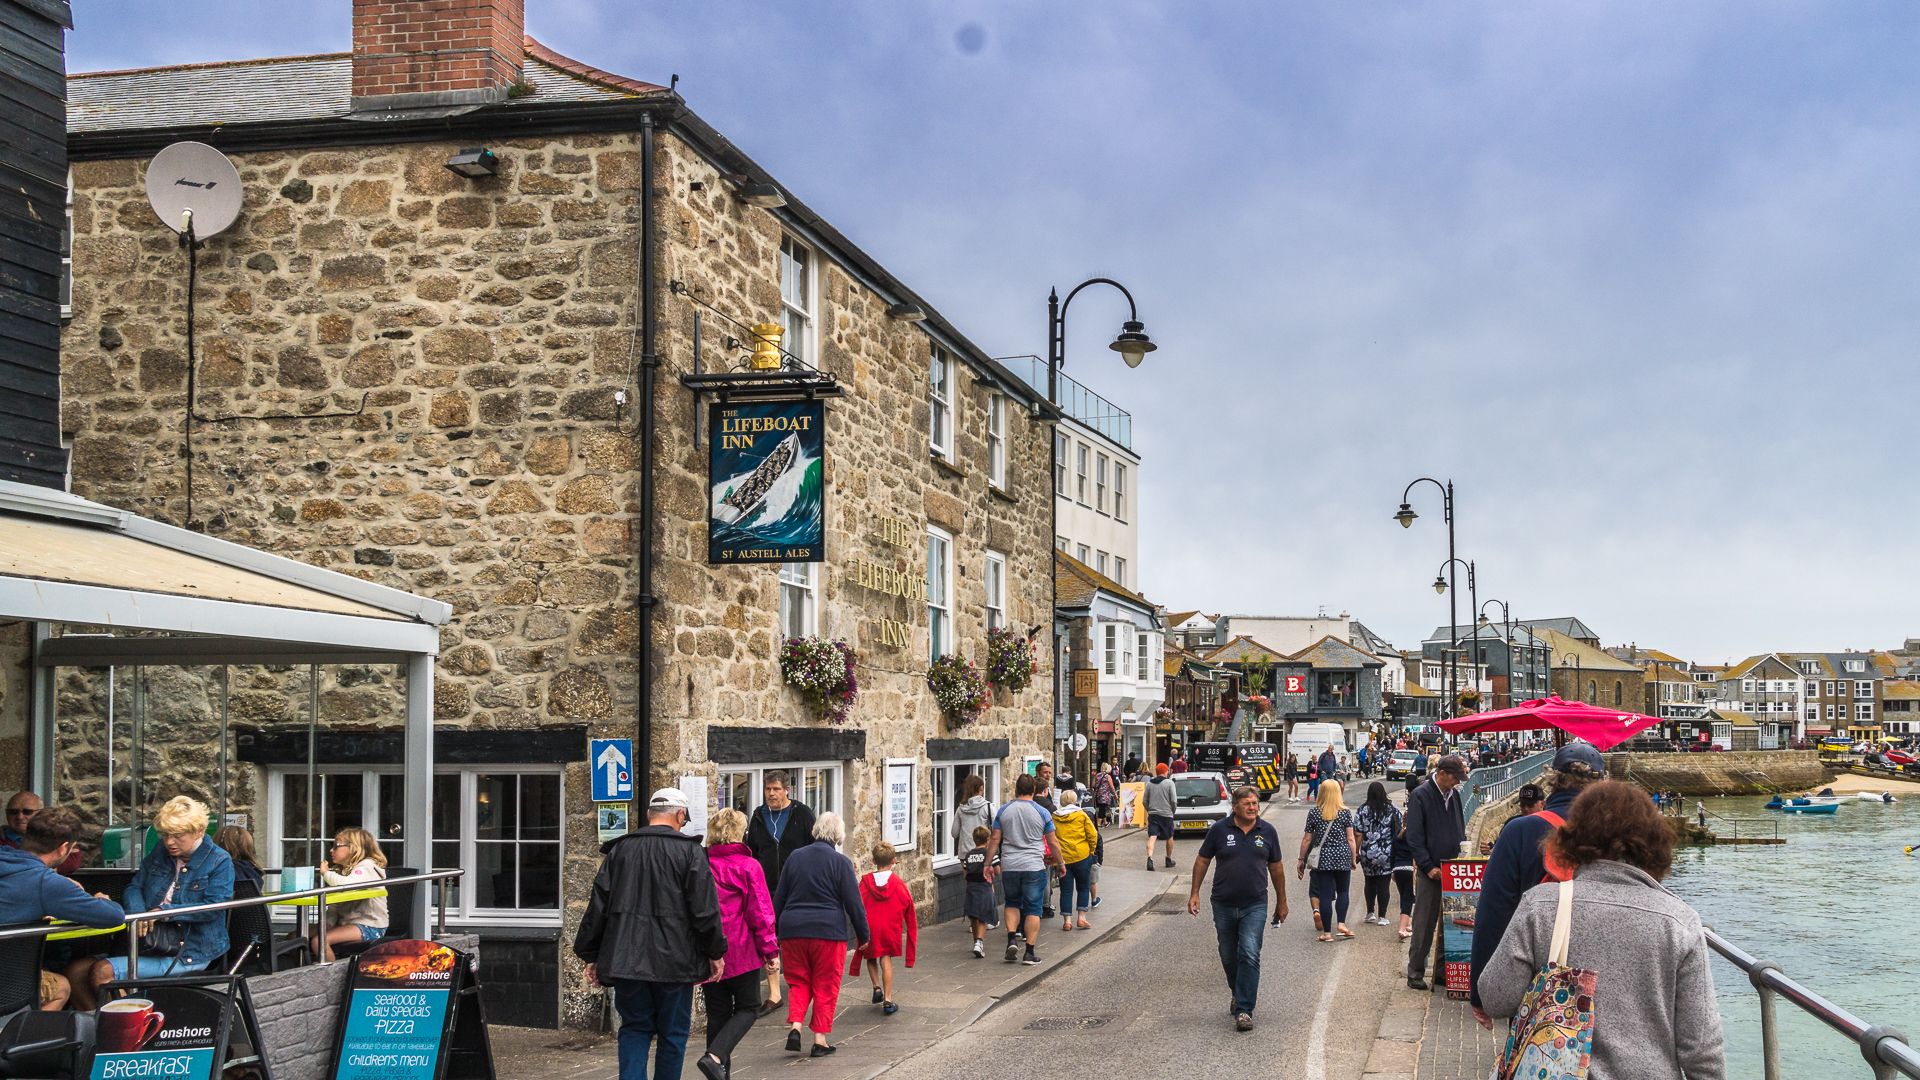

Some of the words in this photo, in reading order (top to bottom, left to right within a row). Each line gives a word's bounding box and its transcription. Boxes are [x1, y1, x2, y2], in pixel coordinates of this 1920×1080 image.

[721, 416, 812, 433] LIFEBOAT
[721, 434, 754, 449] INN
[876, 514, 911, 549] THE
[722, 550, 733, 559] ST
[738, 548, 782, 559] AUSTELL
[785, 548, 810, 558] ALES
[852, 558, 928, 602] LIFEBOAT
[876, 617, 910, 650] INN
[1287, 677, 1300, 691] B
[1450, 864, 1483, 877] SELF
[1453, 877, 1483, 890] BOA
[409, 970, 450, 980] onshore
[418, 994, 427, 1006] &
[159, 1025, 212, 1039] onshore
